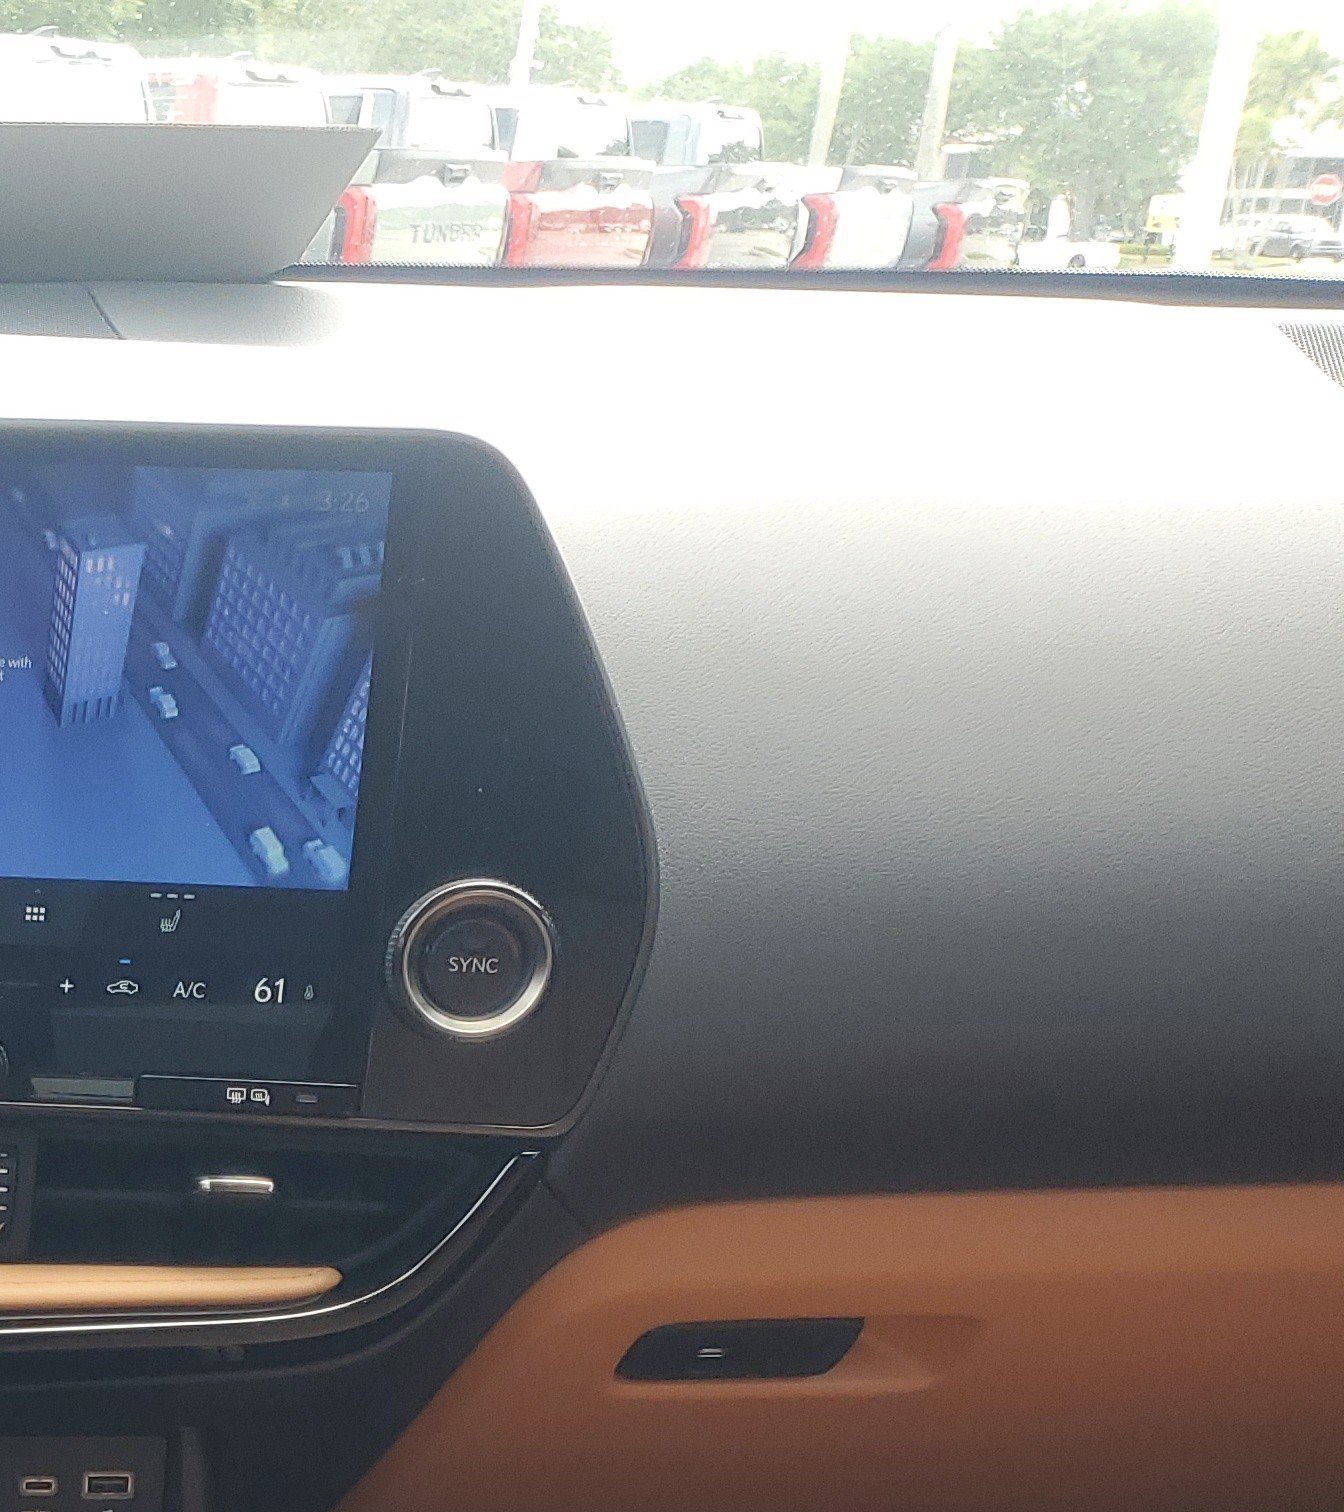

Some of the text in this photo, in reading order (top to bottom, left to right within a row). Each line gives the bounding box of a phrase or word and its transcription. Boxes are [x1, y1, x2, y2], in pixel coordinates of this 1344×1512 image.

[8, 656, 32, 669] with
[448, 956, 500, 976] SYNC
[172, 981, 207, 1000] A/C
[253, 977, 285, 1005] 61
